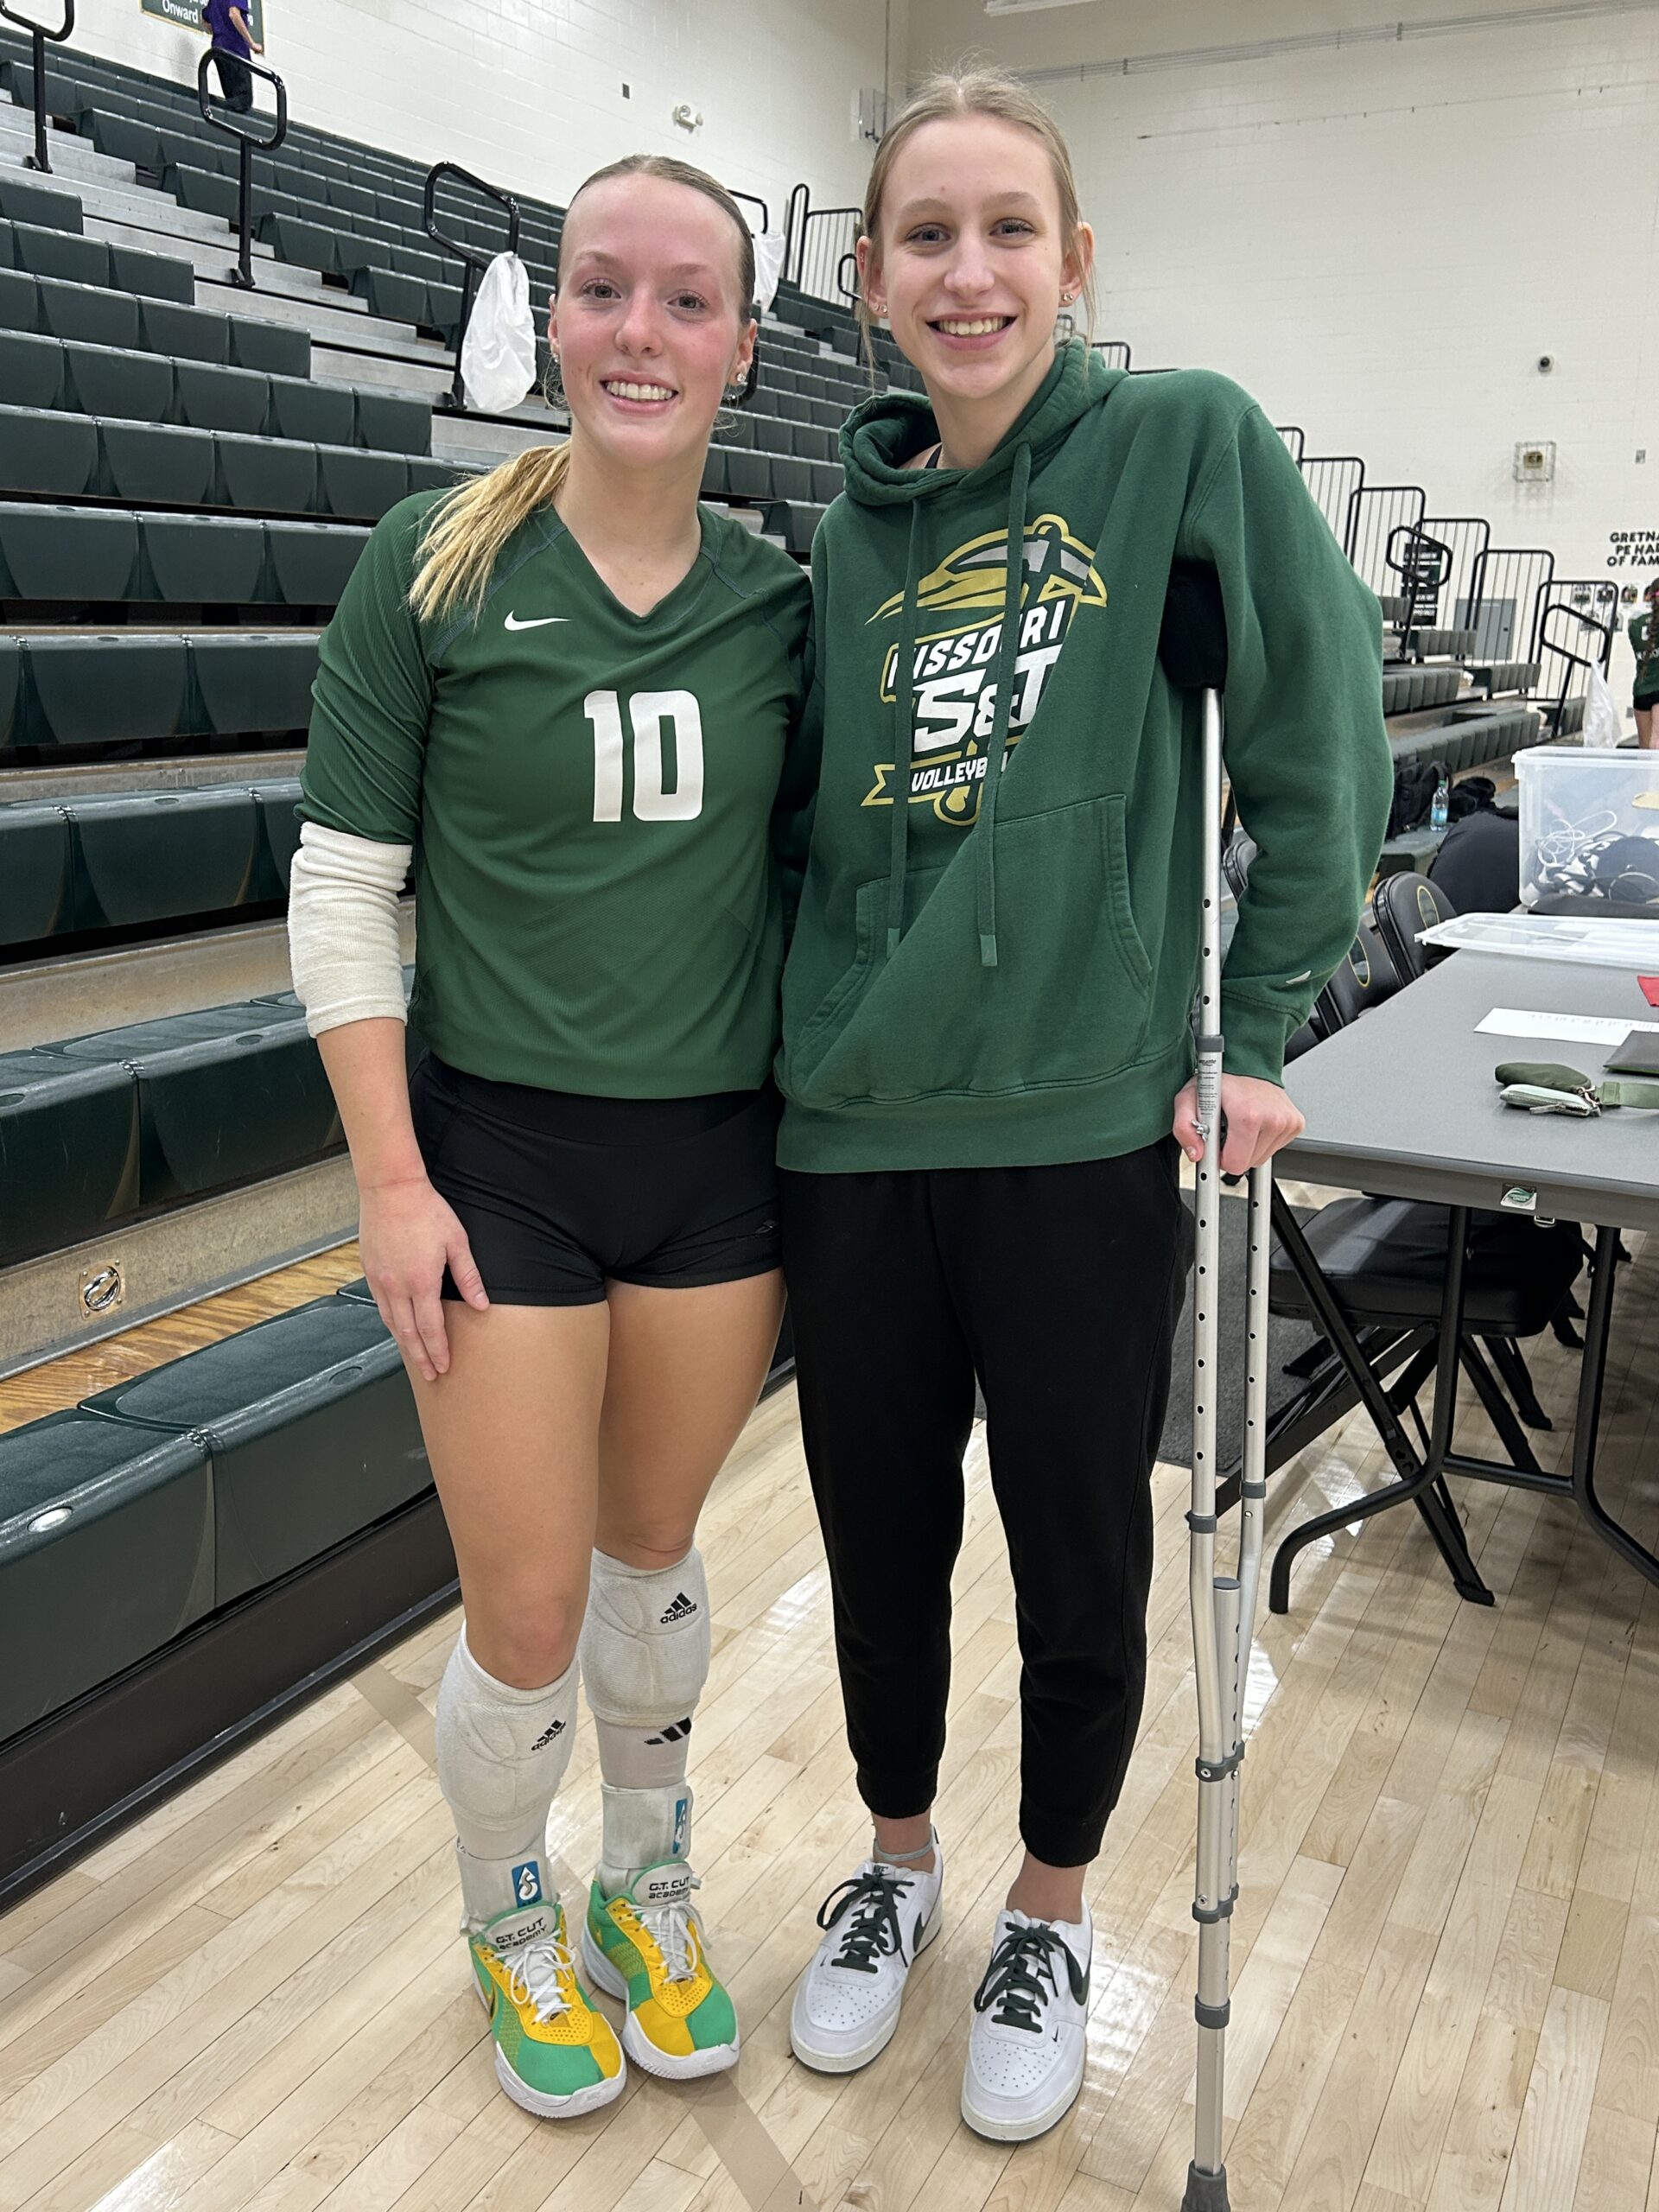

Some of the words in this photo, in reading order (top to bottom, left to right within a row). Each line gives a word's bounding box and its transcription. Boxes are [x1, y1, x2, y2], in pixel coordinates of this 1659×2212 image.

[162, 0, 199, 24] Onward
[1616, 544, 1631, 556] PE
[1606, 556, 1625, 567] OF
[887, 600, 1065, 689] ISSORI
[583, 690, 704, 822] 10
[660, 1603, 697, 1624] adidas
[648, 1887, 689, 1899] academ
[671, 1876, 690, 1889] CUT
[518, 1916, 544, 1937] CUT
